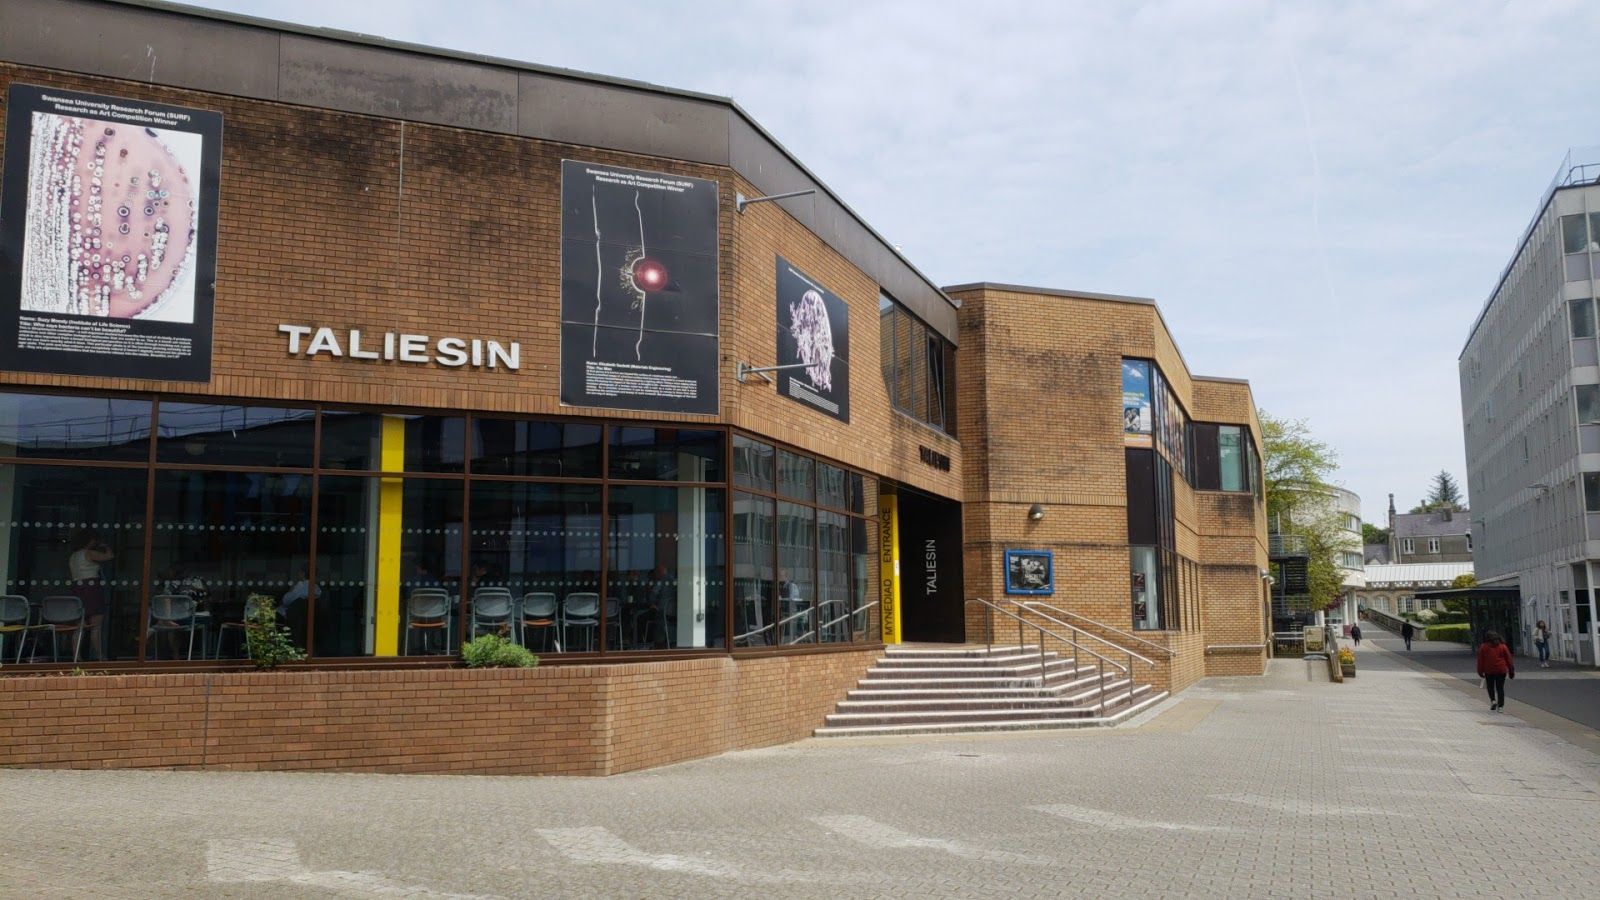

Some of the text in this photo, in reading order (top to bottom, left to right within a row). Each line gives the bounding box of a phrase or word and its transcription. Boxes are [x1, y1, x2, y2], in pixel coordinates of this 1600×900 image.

[41, 94, 191, 122] Swansea University Research Forum (SURF)
[54, 103, 88, 114] Research
[99, 109, 111, 117] Art
[111, 111, 153, 123] Competition
[153, 117, 178, 126] Winner
[586, 168, 609, 176] Swansea
[610, 171, 635, 181] University
[635, 174, 660, 183] Research
[676, 181, 693, 189] (SURF)
[595, 175, 620, 184] Research
[636, 181, 667, 190] Competition
[278, 324, 520, 370] TALIESIN
[882, 506, 893, 636] MYNEDIAD ENTRANCE
[925, 539, 937, 595] TALIESIN
